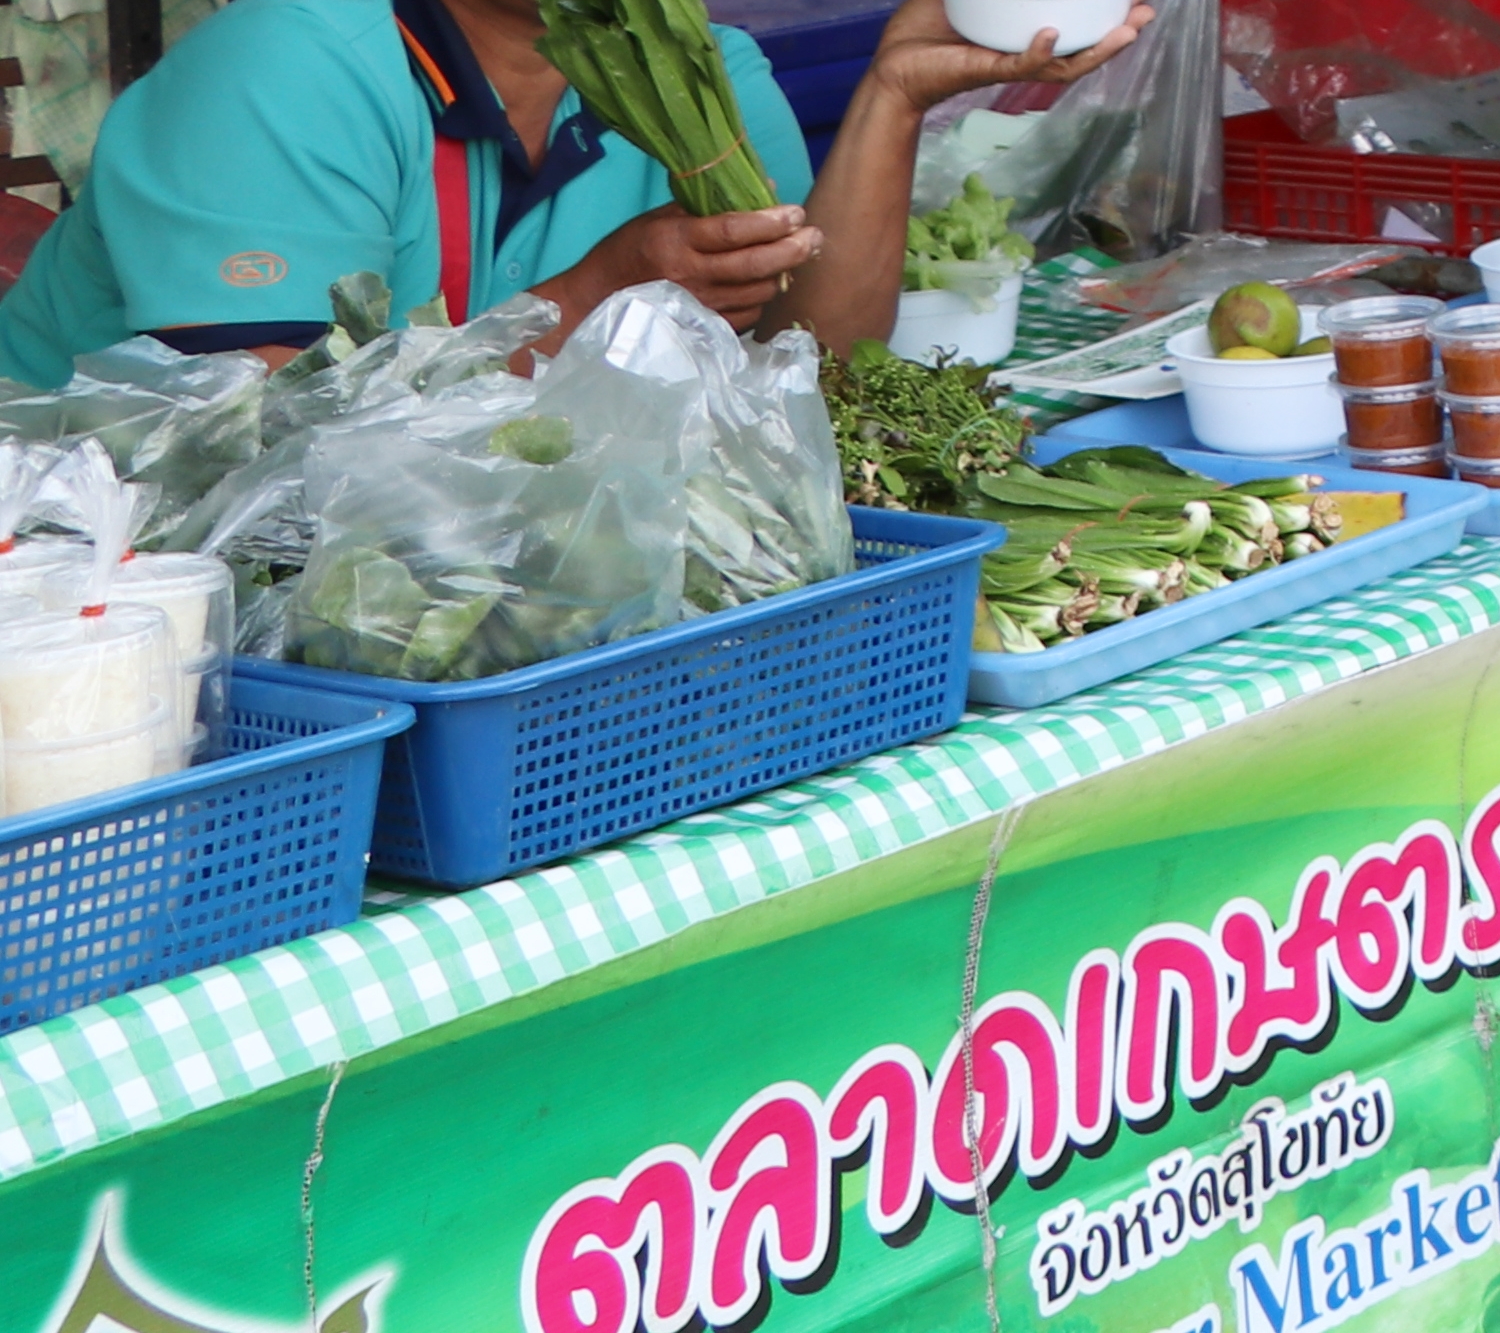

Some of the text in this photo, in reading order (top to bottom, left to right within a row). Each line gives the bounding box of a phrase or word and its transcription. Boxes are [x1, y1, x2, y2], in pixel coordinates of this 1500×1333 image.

[1041, 1081, 1388, 1307] จังหวัดสุโขทัย
